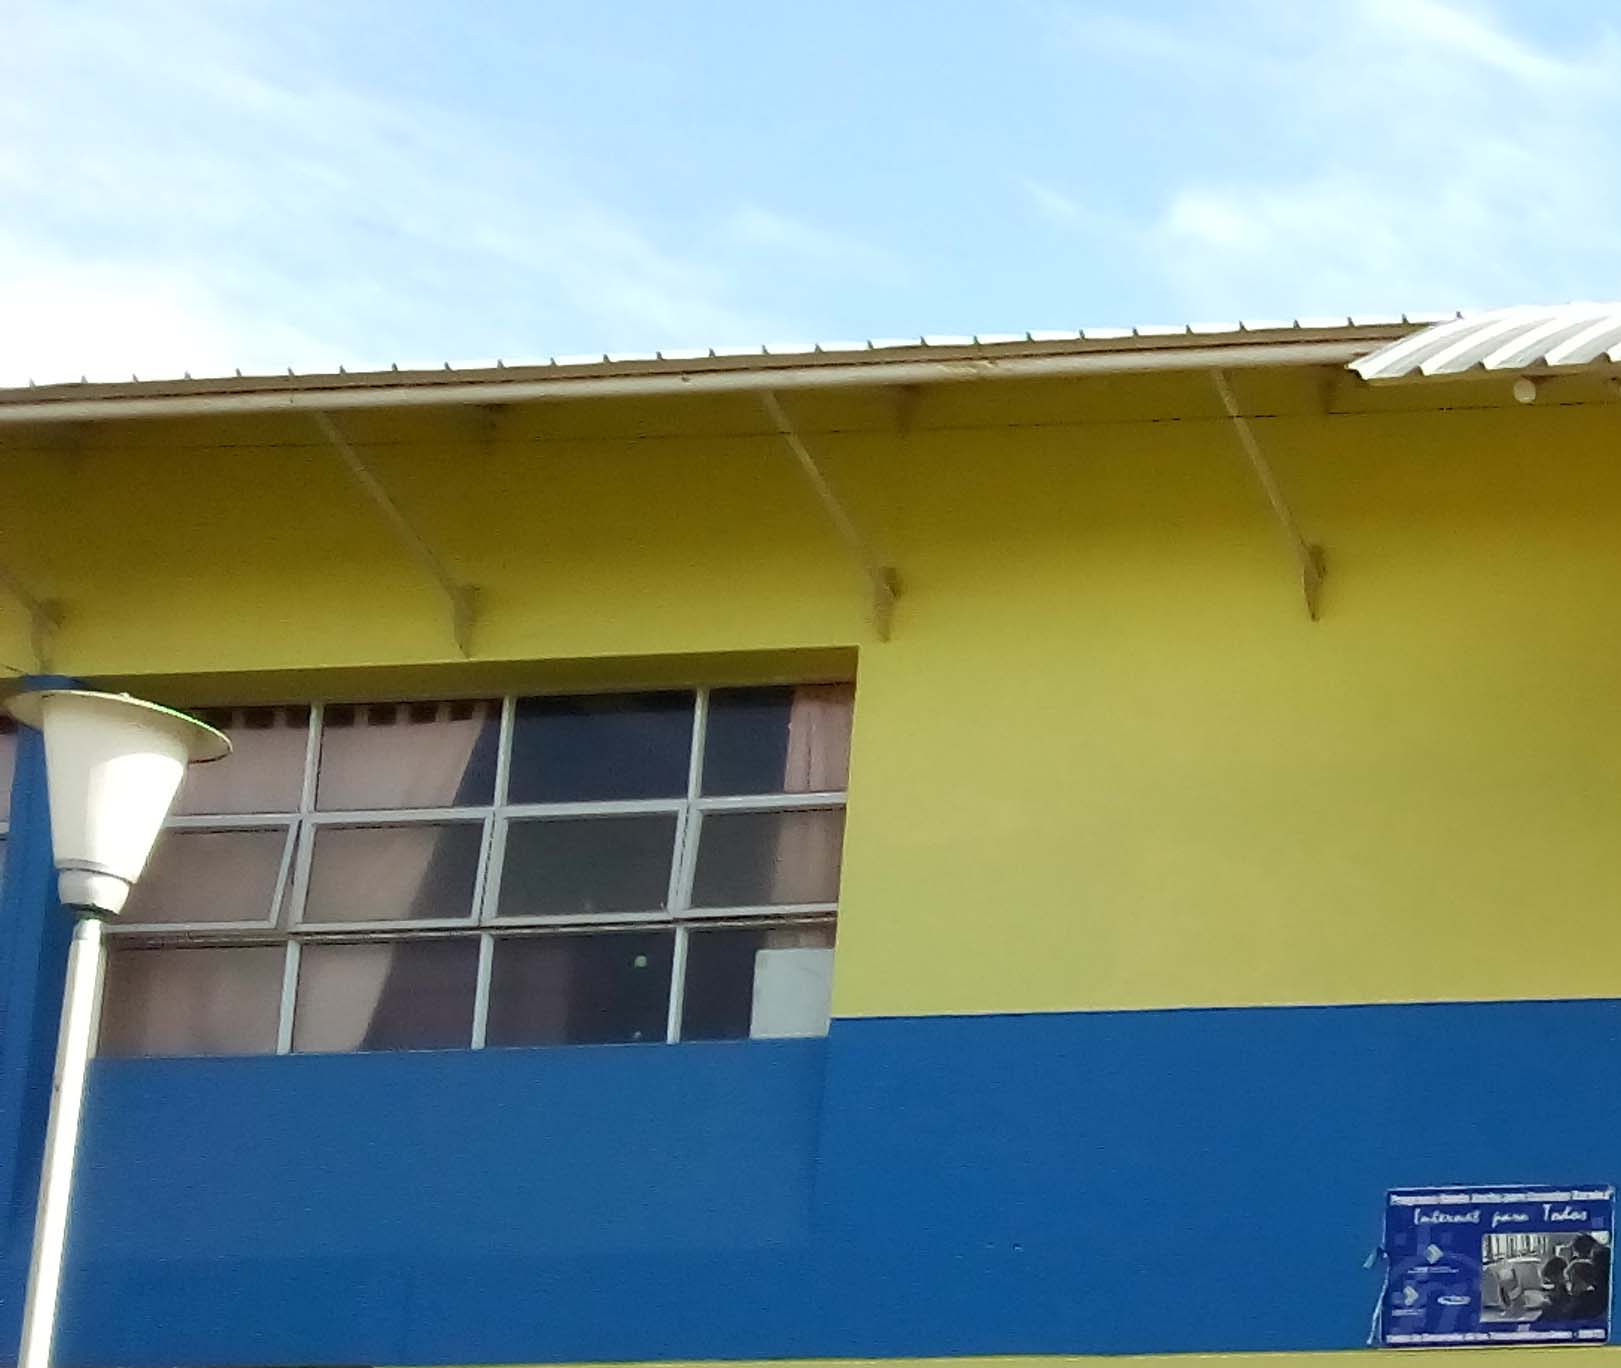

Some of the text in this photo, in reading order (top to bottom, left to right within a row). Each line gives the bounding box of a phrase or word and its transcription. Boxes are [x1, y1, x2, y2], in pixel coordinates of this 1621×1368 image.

[1413, 1203, 1588, 1228] Internet para Todos
